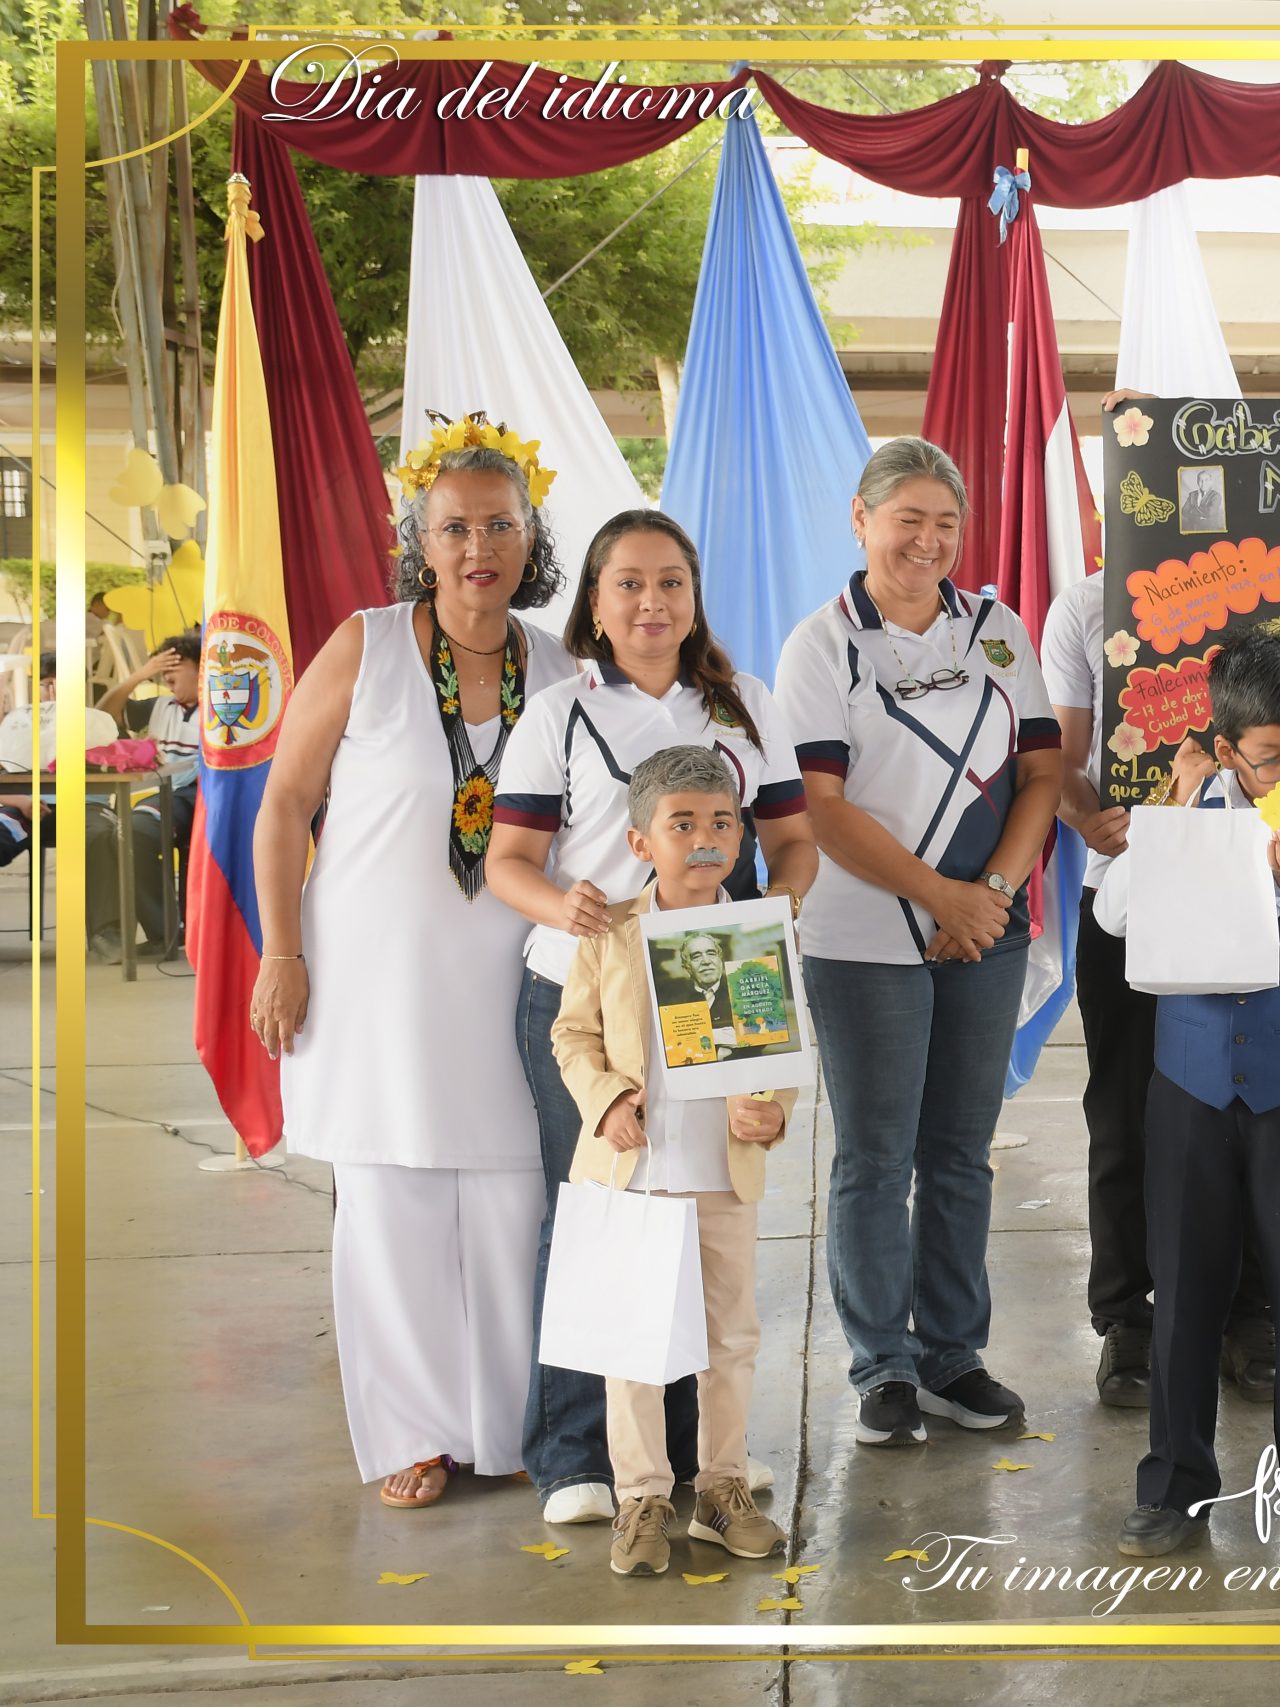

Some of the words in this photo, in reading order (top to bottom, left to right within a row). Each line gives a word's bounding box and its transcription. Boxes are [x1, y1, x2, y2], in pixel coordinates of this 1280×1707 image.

[1144, 550, 1248, 606] Nacimiento:
[217, 615, 240, 629] DE
[1133, 671, 1210, 700] Fallecim
[1161, 697, 1178, 711] de
[1183, 688, 1207, 705] abri
[1148, 708, 1189, 733] Ciudad
[1109, 784, 1142, 802] que
[740, 976, 768, 985] GABRIEL
